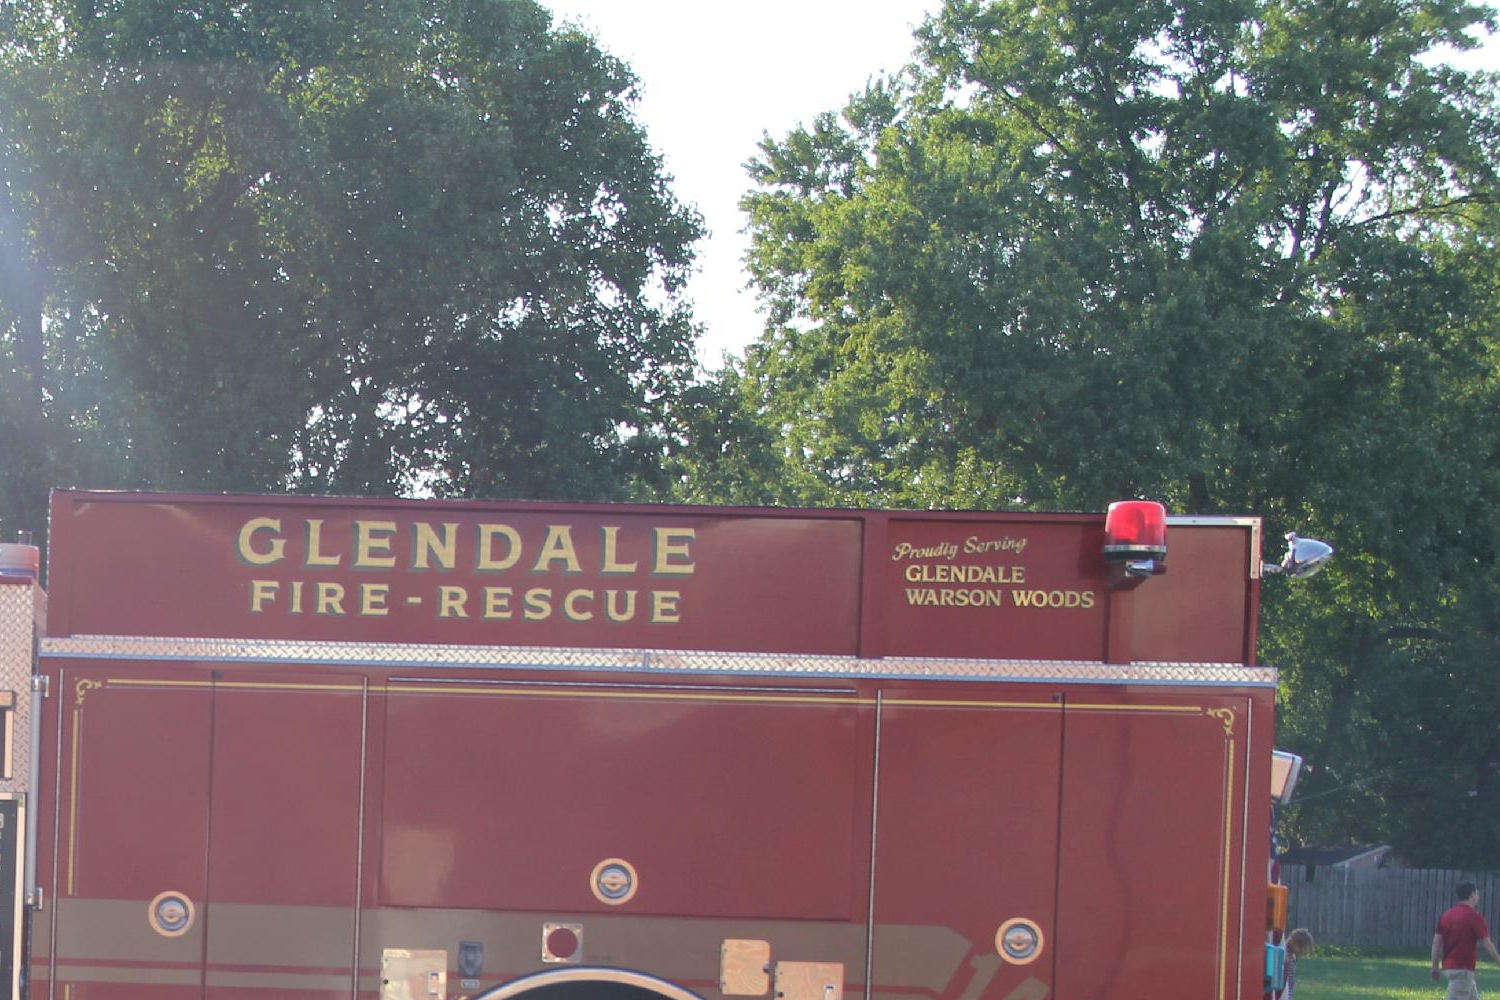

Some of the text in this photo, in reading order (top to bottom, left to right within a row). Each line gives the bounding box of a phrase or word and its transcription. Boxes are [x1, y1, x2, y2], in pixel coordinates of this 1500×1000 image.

[237, 517, 696, 575] GLENDALE
[891, 536, 1028, 561] Proudly Serving
[903, 564, 1026, 584] GLENDALE
[904, 588, 1096, 609] WARSON WOODS
